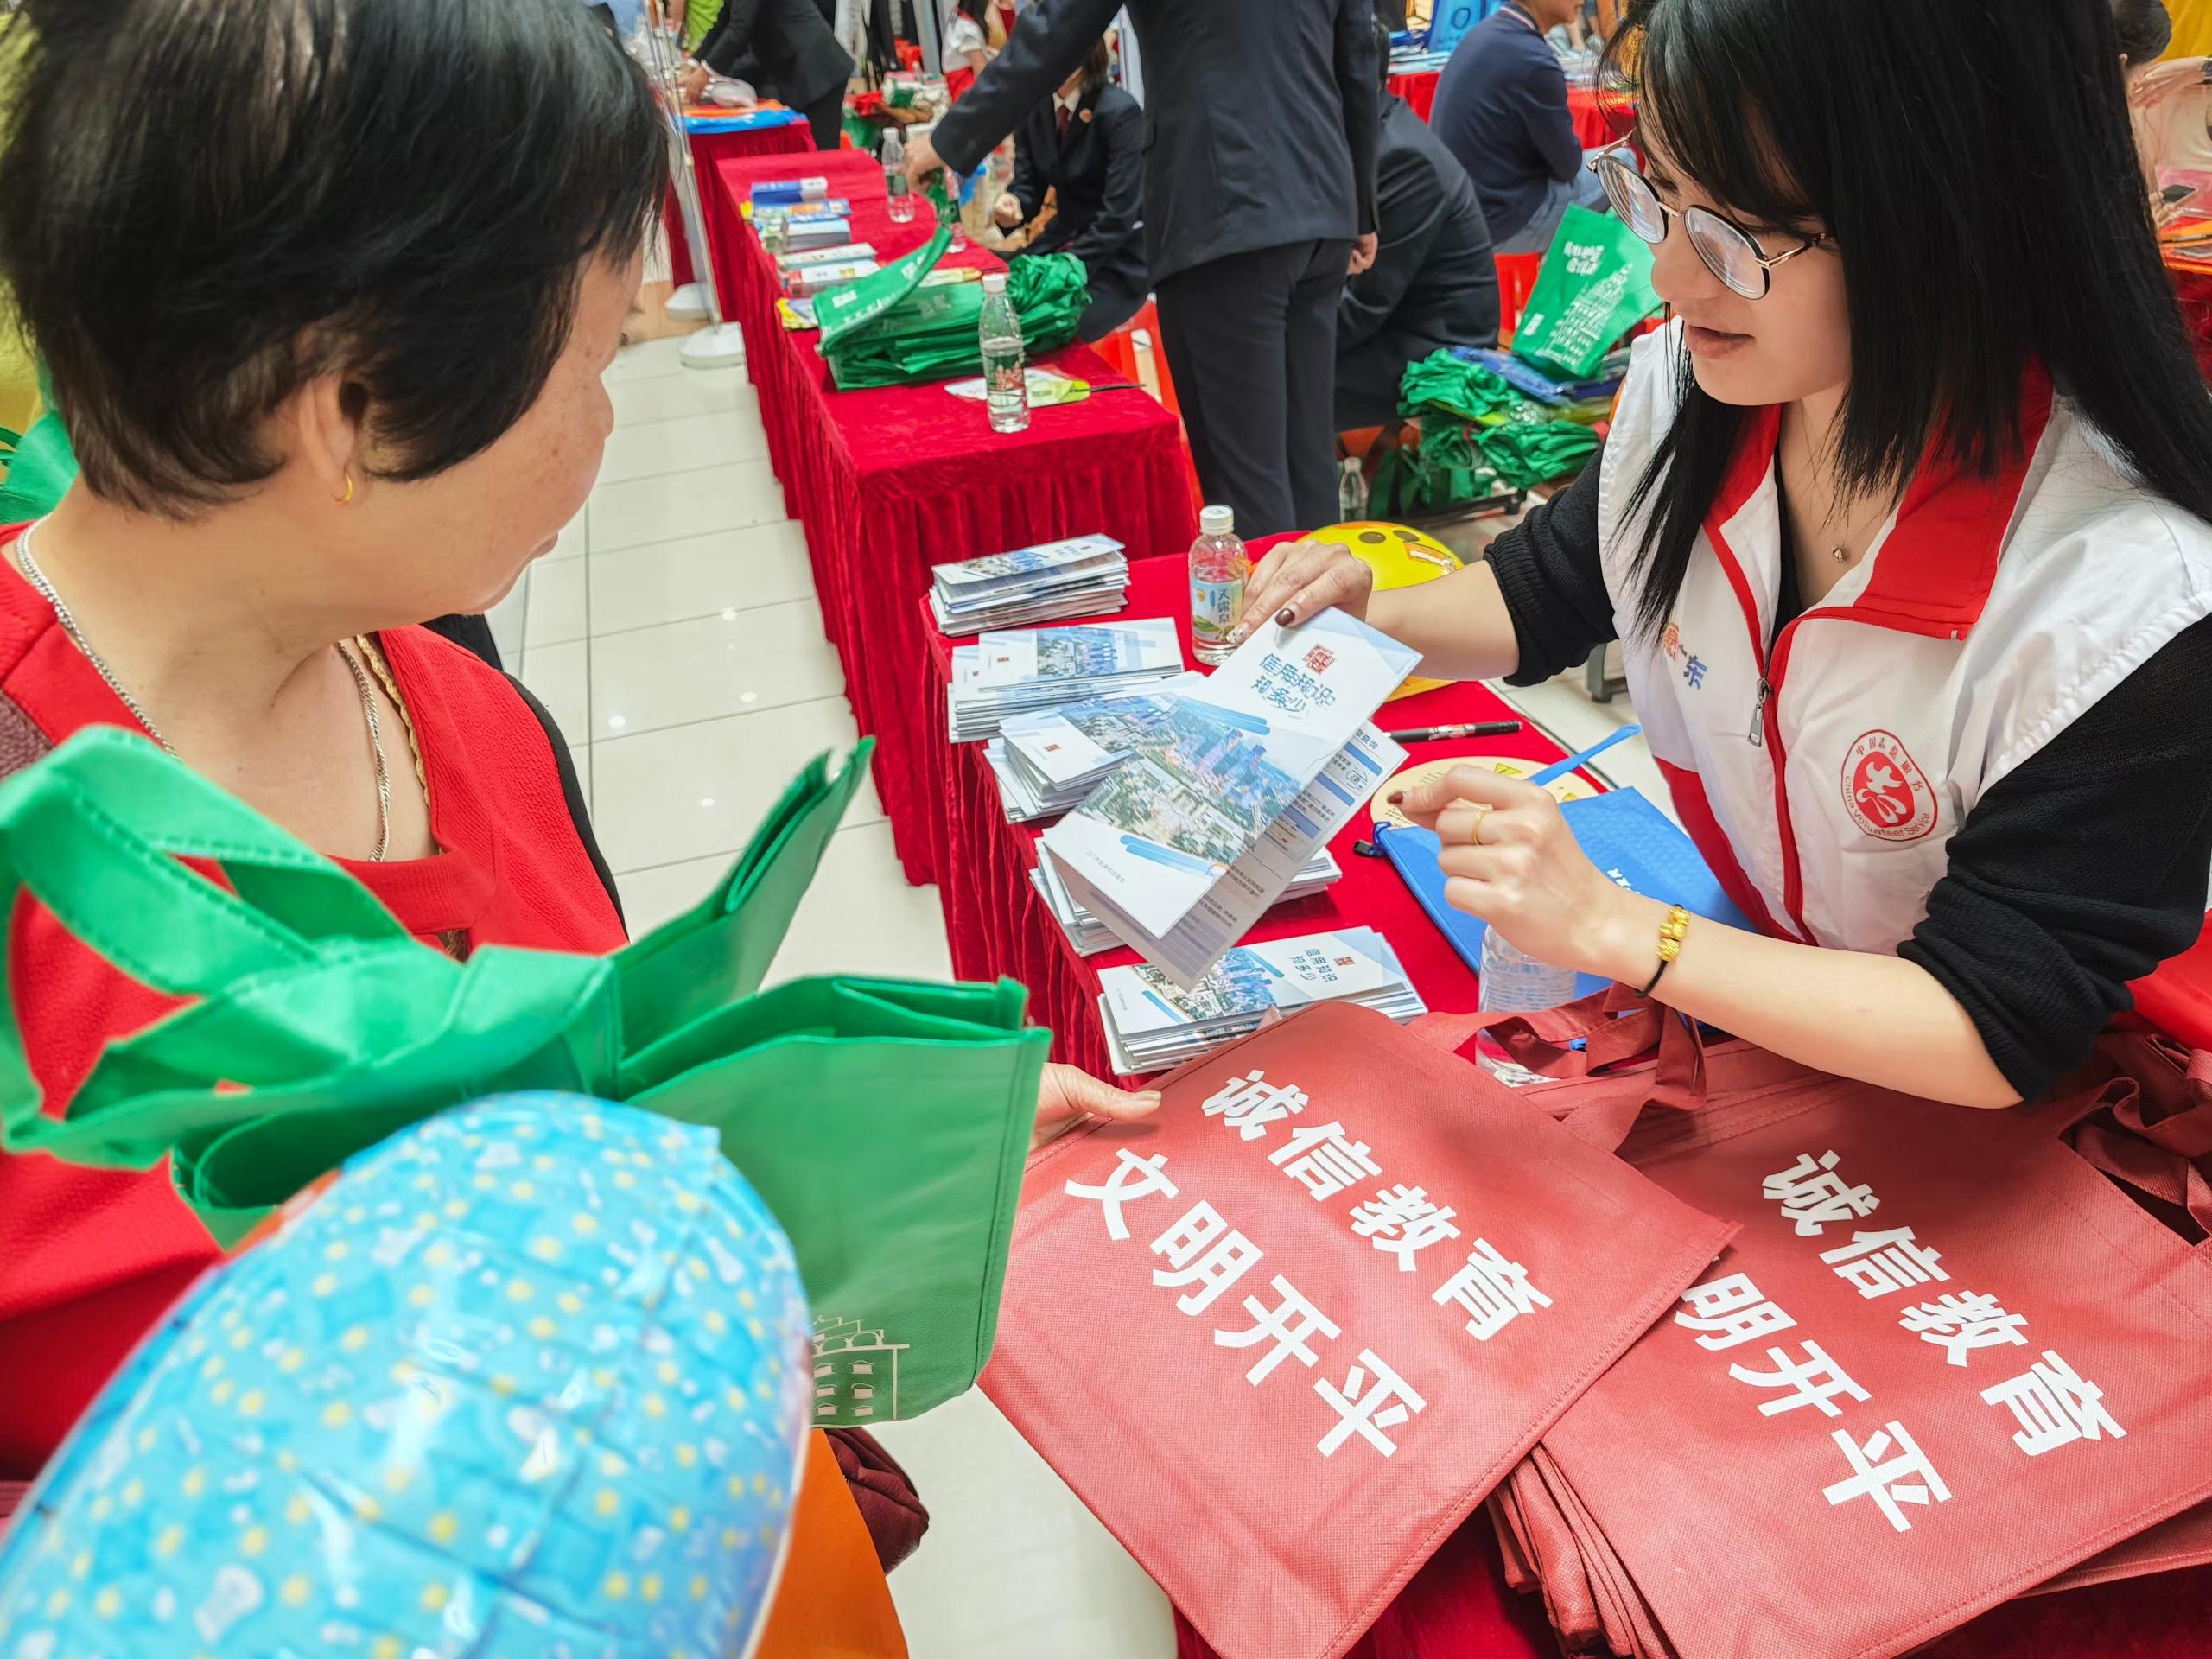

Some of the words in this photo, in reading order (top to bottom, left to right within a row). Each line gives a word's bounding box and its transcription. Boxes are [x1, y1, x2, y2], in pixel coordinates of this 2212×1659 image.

[1845, 775, 1855, 809] China
[1853, 808, 1904, 837] Volunteer
[1904, 812, 1931, 835] Service
[1065, 1147, 1427, 1459] 文明开平
[1200, 1069, 1553, 1341] 诚信教育
[1761, 1149, 2127, 1457] 诚信教育
[1673, 1270, 1953, 1533] 明开平
